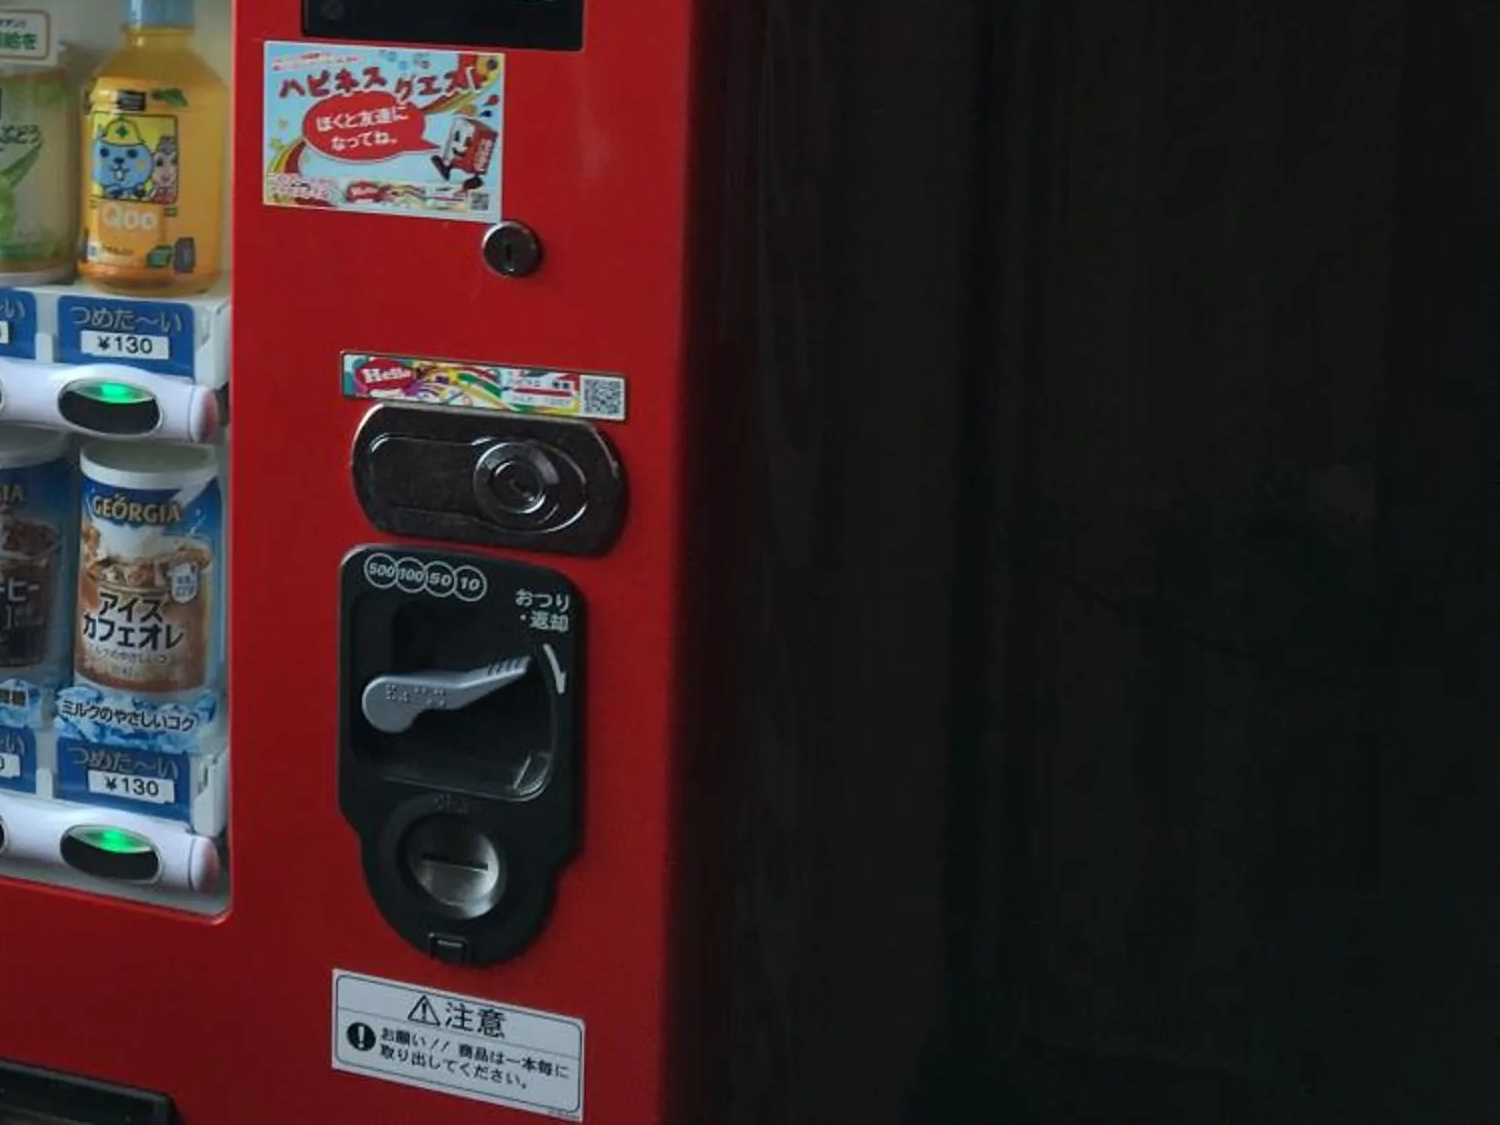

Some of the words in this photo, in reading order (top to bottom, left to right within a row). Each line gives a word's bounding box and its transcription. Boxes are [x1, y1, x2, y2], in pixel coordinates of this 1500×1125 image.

[278, 66, 388, 99] ハピネス
[100, 203, 160, 232] Qoo
[97, 334, 155, 355] ¥130
[368, 562, 396, 578] 500
[399, 567, 426, 583] 100
[429, 571, 453, 587] 50
[460, 577, 481, 592] 10
[99, 591, 162, 624] アイス
[515, 588, 571, 613] おつり
[83, 614, 185, 651] カフェオレ
[62, 699, 198, 732] ミルクのやさしいコク
[104, 776, 160, 797] ¥130
[444, 1001, 508, 1039] 注意
[379, 1043, 528, 1090] 取り出してください。
